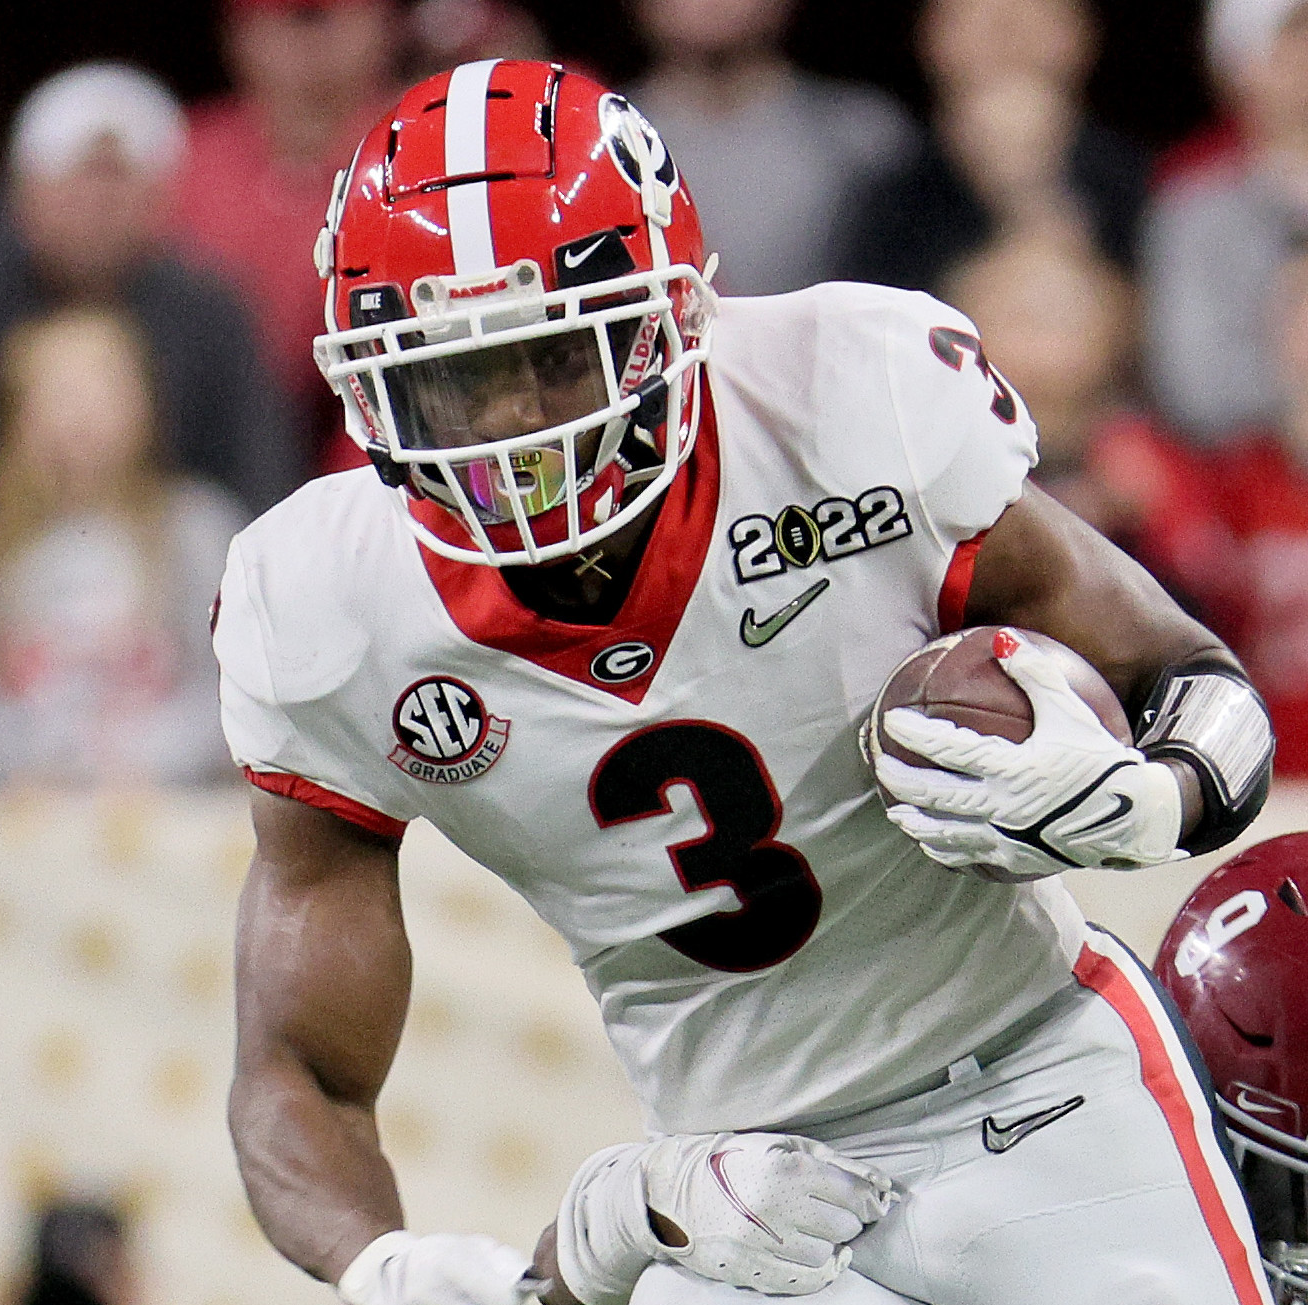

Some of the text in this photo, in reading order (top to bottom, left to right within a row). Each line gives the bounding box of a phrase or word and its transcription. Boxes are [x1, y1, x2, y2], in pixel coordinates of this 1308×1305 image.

[928, 326, 1017, 425] 3
[728, 485, 914, 584] 2022
[603, 646, 652, 677] G
[398, 682, 480, 758] SEC
[409, 740, 500, 782] GRADUATE
[587, 718, 823, 973] 3
